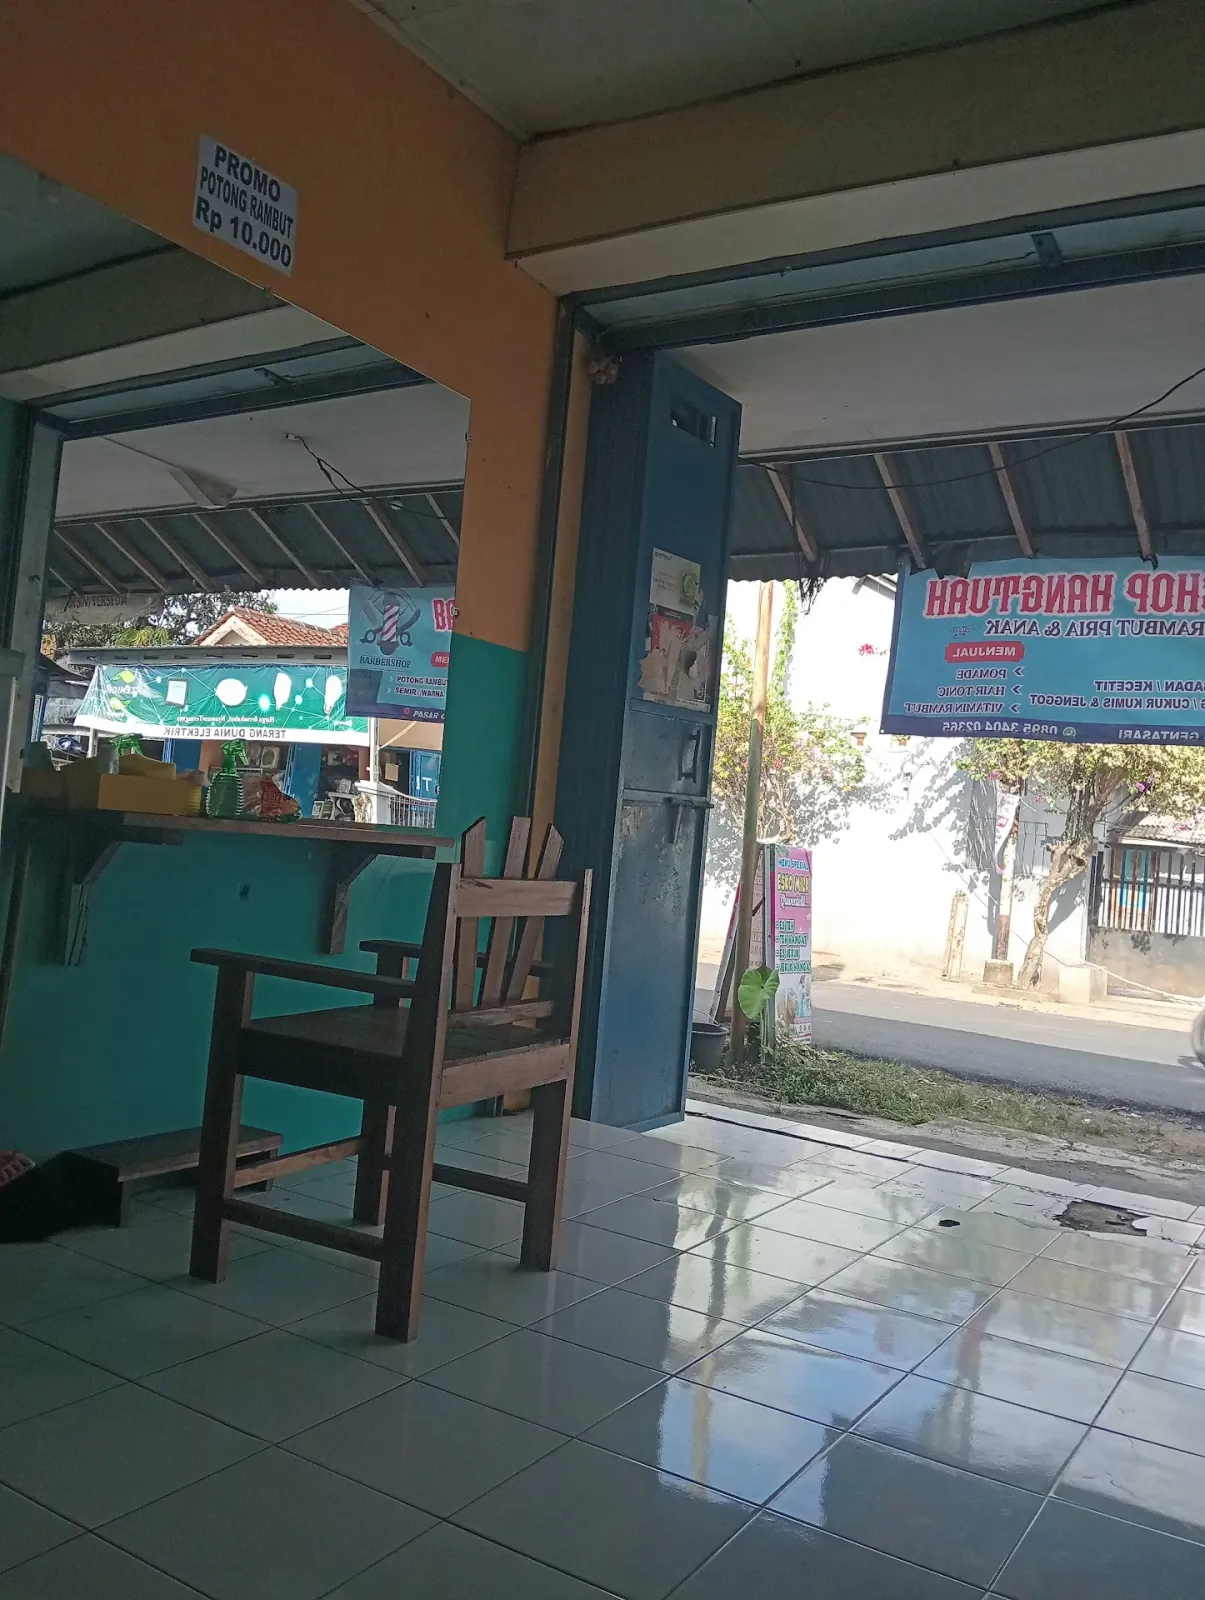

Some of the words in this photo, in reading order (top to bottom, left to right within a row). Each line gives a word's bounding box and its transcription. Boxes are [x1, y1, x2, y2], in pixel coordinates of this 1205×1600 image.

[214, 144, 281, 203] PROMO
[200, 165, 247, 213] POTONG
[250, 194, 294, 239] RAMBUT
[195, 195, 222, 233] Rp
[229, 215, 292, 267] 10.000
[359, 655, 412, 669] BARBERSHOP
[396, 676, 424, 685] POTONG
[395, 686, 417, 696] SEMIR
[421, 688, 444, 698] WARNA
[413, 710, 438, 720] PASAR
